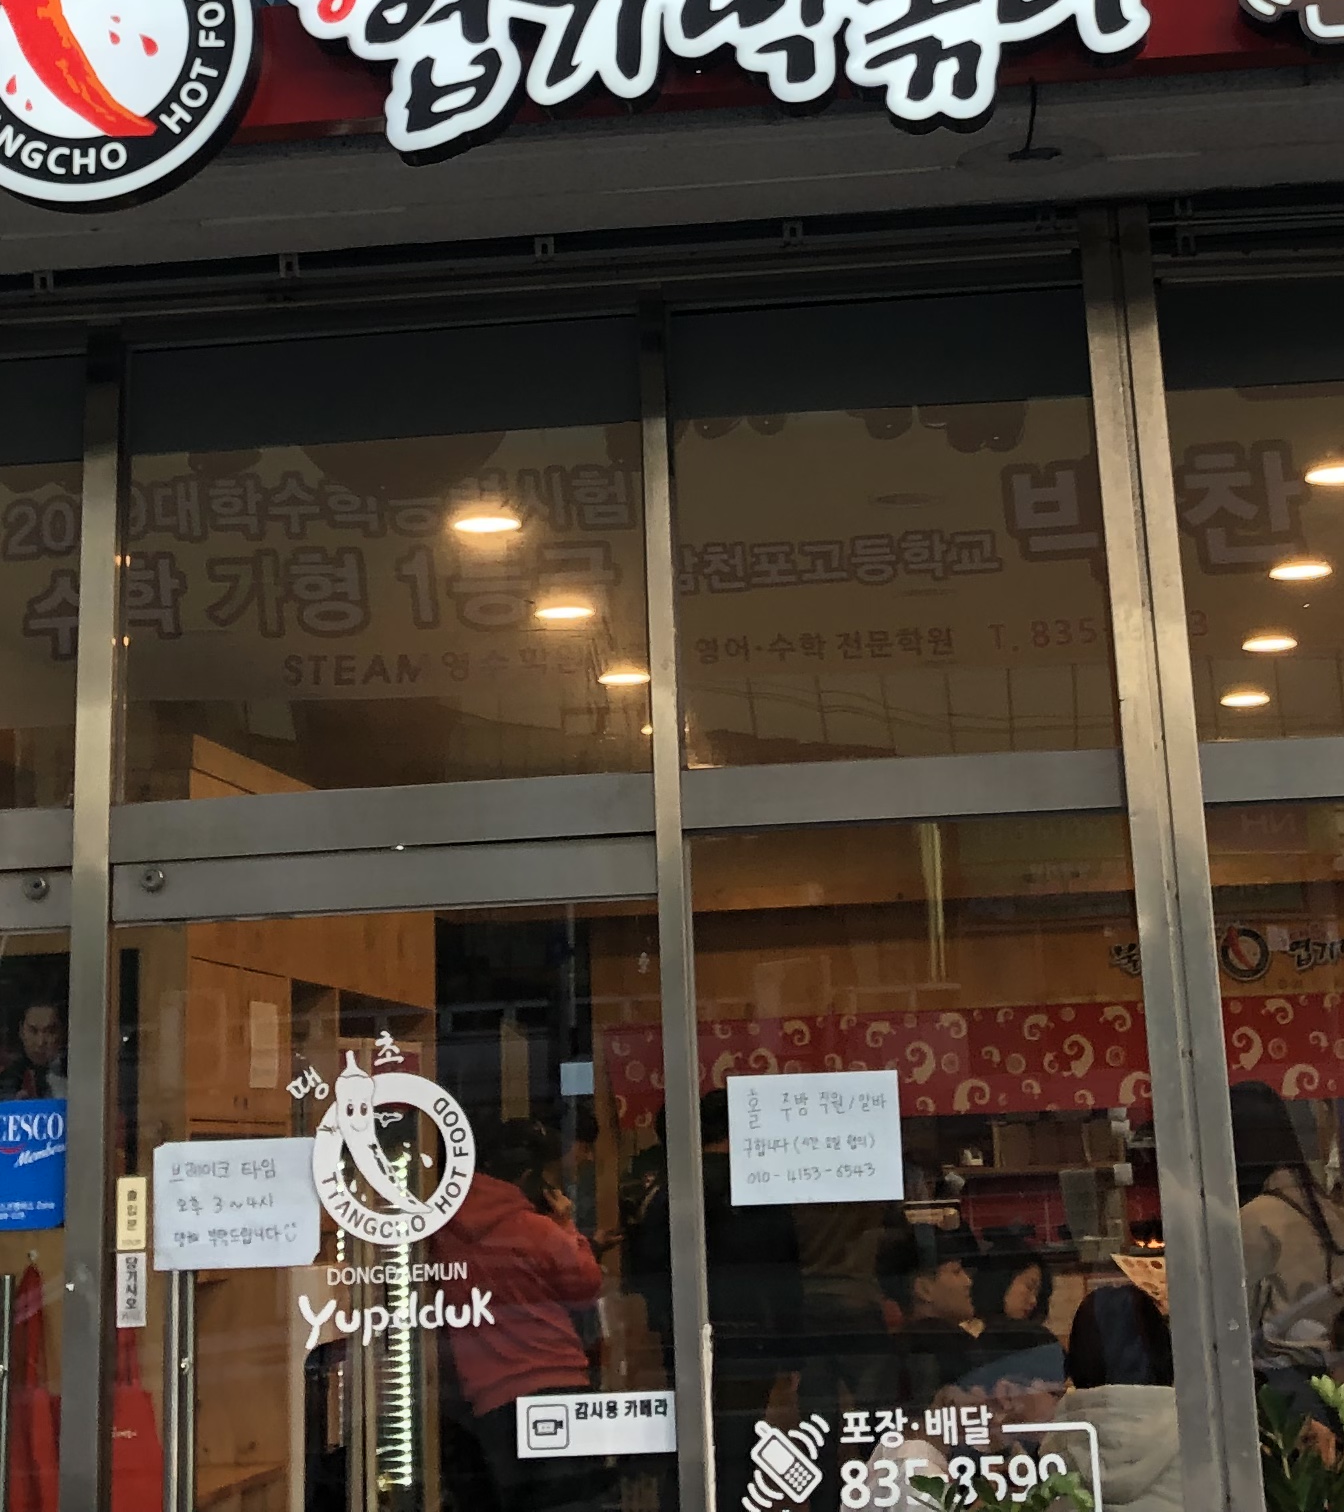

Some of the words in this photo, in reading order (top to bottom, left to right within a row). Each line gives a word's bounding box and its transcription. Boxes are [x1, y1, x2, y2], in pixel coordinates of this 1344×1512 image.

[159, 57, 219, 135] HOT
[205, 542, 370, 638] 가형
[837, 625, 955, 661] 전문학원
[779, 1091, 810, 1123] 주방
[432, 1096, 469, 1159] FOOD
[241, 1156, 276, 1179] 타임
[175, 1195, 204, 1216] 오후
[321, 1171, 427, 1240] TTANGCHO
[436, 1167, 468, 1216] HOT
[327, 1261, 468, 1286] DONGDAEMUN
[575, 1400, 619, 1420] 감시용
[624, 1398, 668, 1418] 카메라
